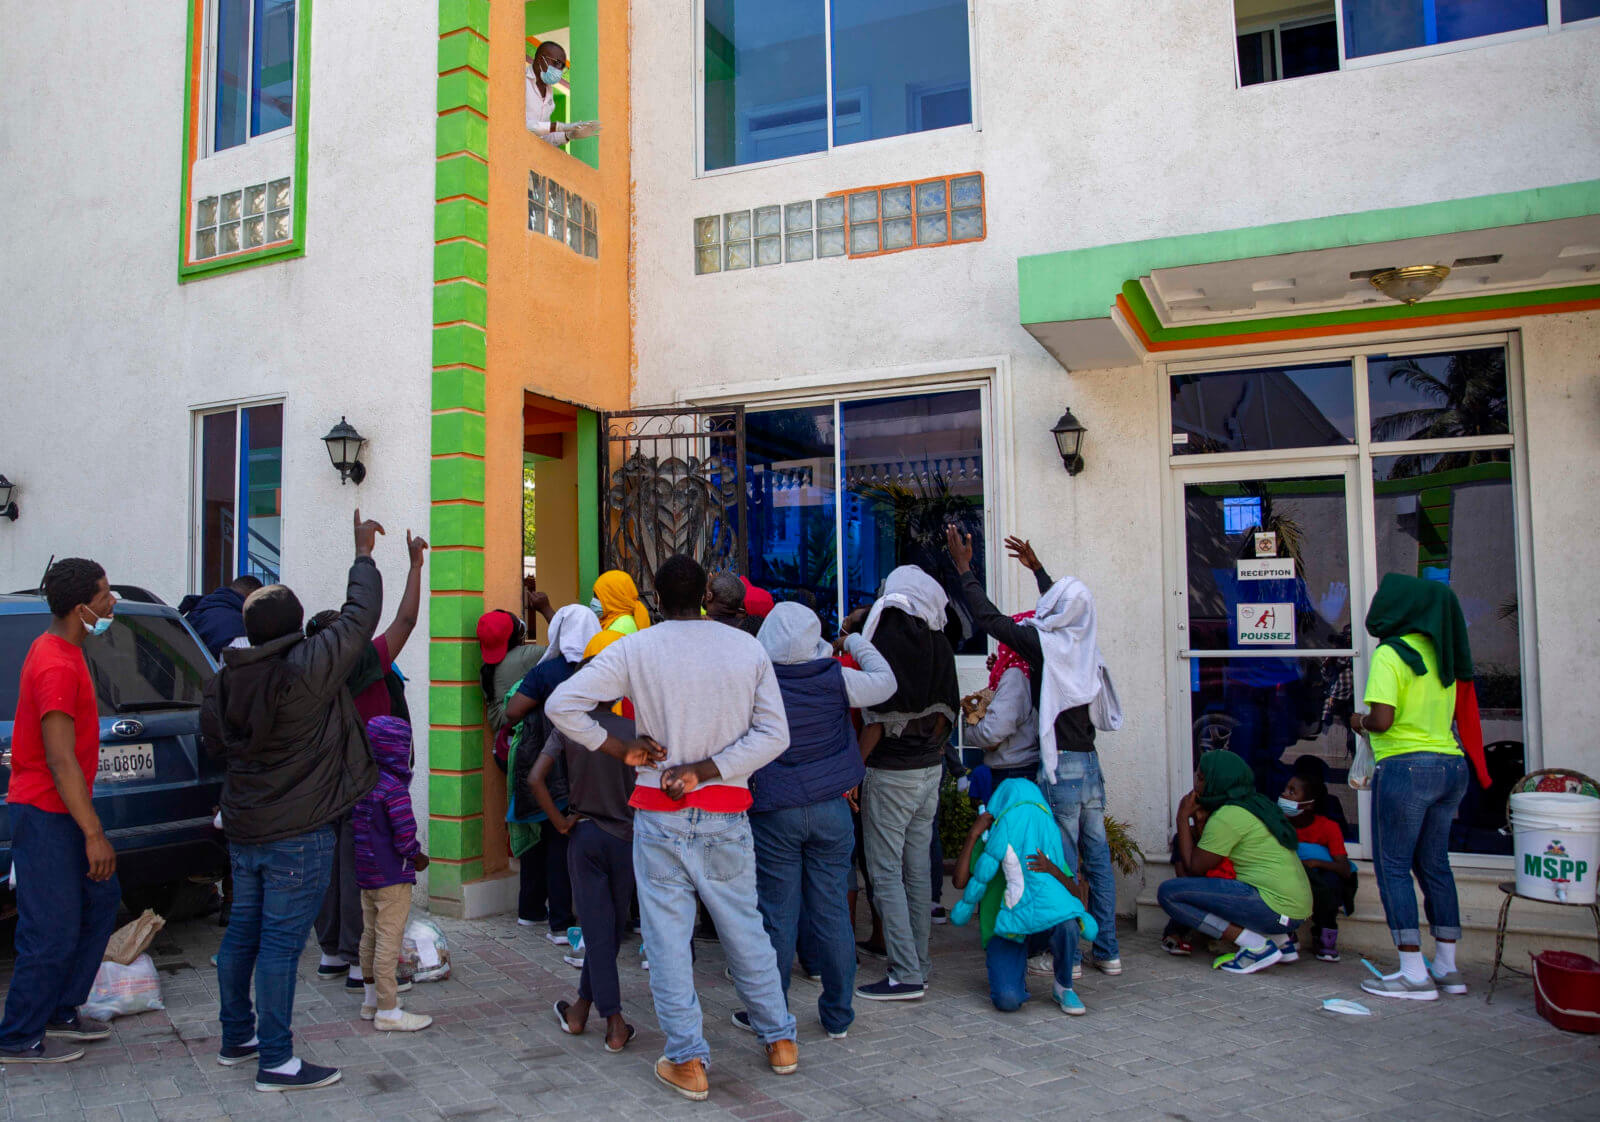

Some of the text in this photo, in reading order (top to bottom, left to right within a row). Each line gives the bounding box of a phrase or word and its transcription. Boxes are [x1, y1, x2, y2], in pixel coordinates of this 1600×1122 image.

[1240, 569, 1291, 577] RECEPTION
[1240, 632, 1291, 640] POUSSEZ
[1524, 853, 1588, 882] MSPP
